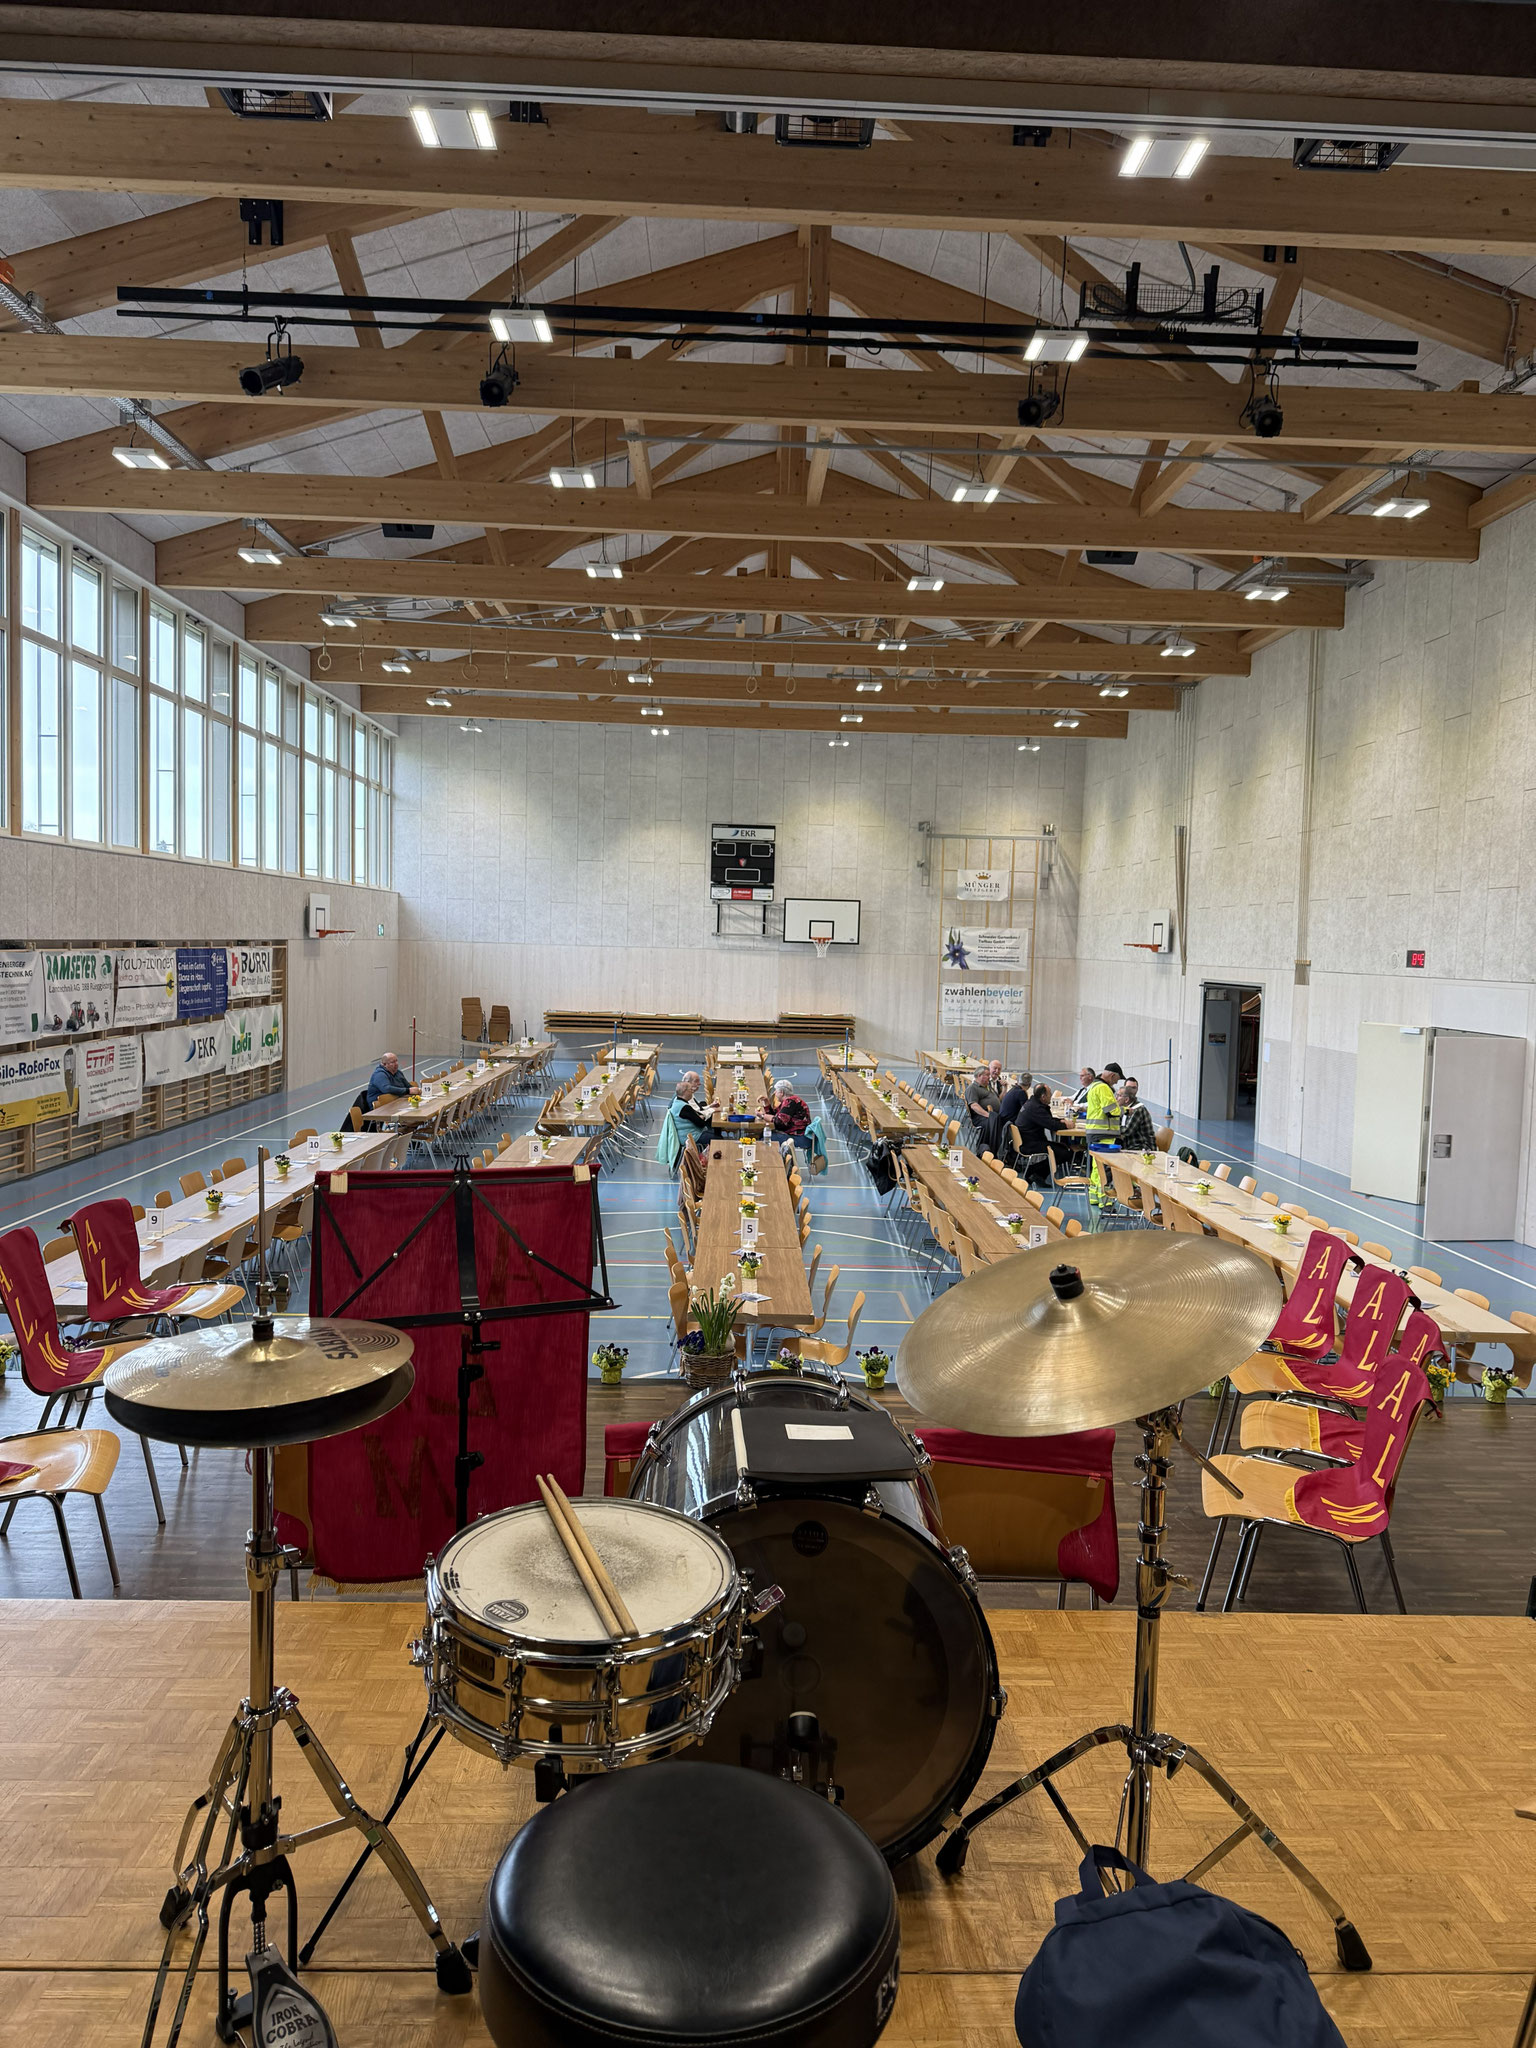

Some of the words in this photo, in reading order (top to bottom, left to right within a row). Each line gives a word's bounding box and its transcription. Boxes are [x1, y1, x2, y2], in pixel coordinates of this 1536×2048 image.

[740, 829, 756, 837] EKR
[964, 881, 1000, 889] MÜNGER
[46, 955, 97, 982] RAMSEYER
[241, 952, 270, 974] BURRI
[945, 986, 1023, 999] zwahlenbeyeler
[198, 1036, 217, 1059] EKR
[310, 1141, 319, 1149] 10
[533, 1145, 538, 1153] 8
[151, 1215, 158, 1225] 9
[747, 1225, 753, 1233] 5
[1035, 1234, 1041, 1242] 3
[309, 1326, 358, 1360] SABIAN
[271, 2004, 302, 2027] IRON
[266, 2014, 319, 2045] COBRA
